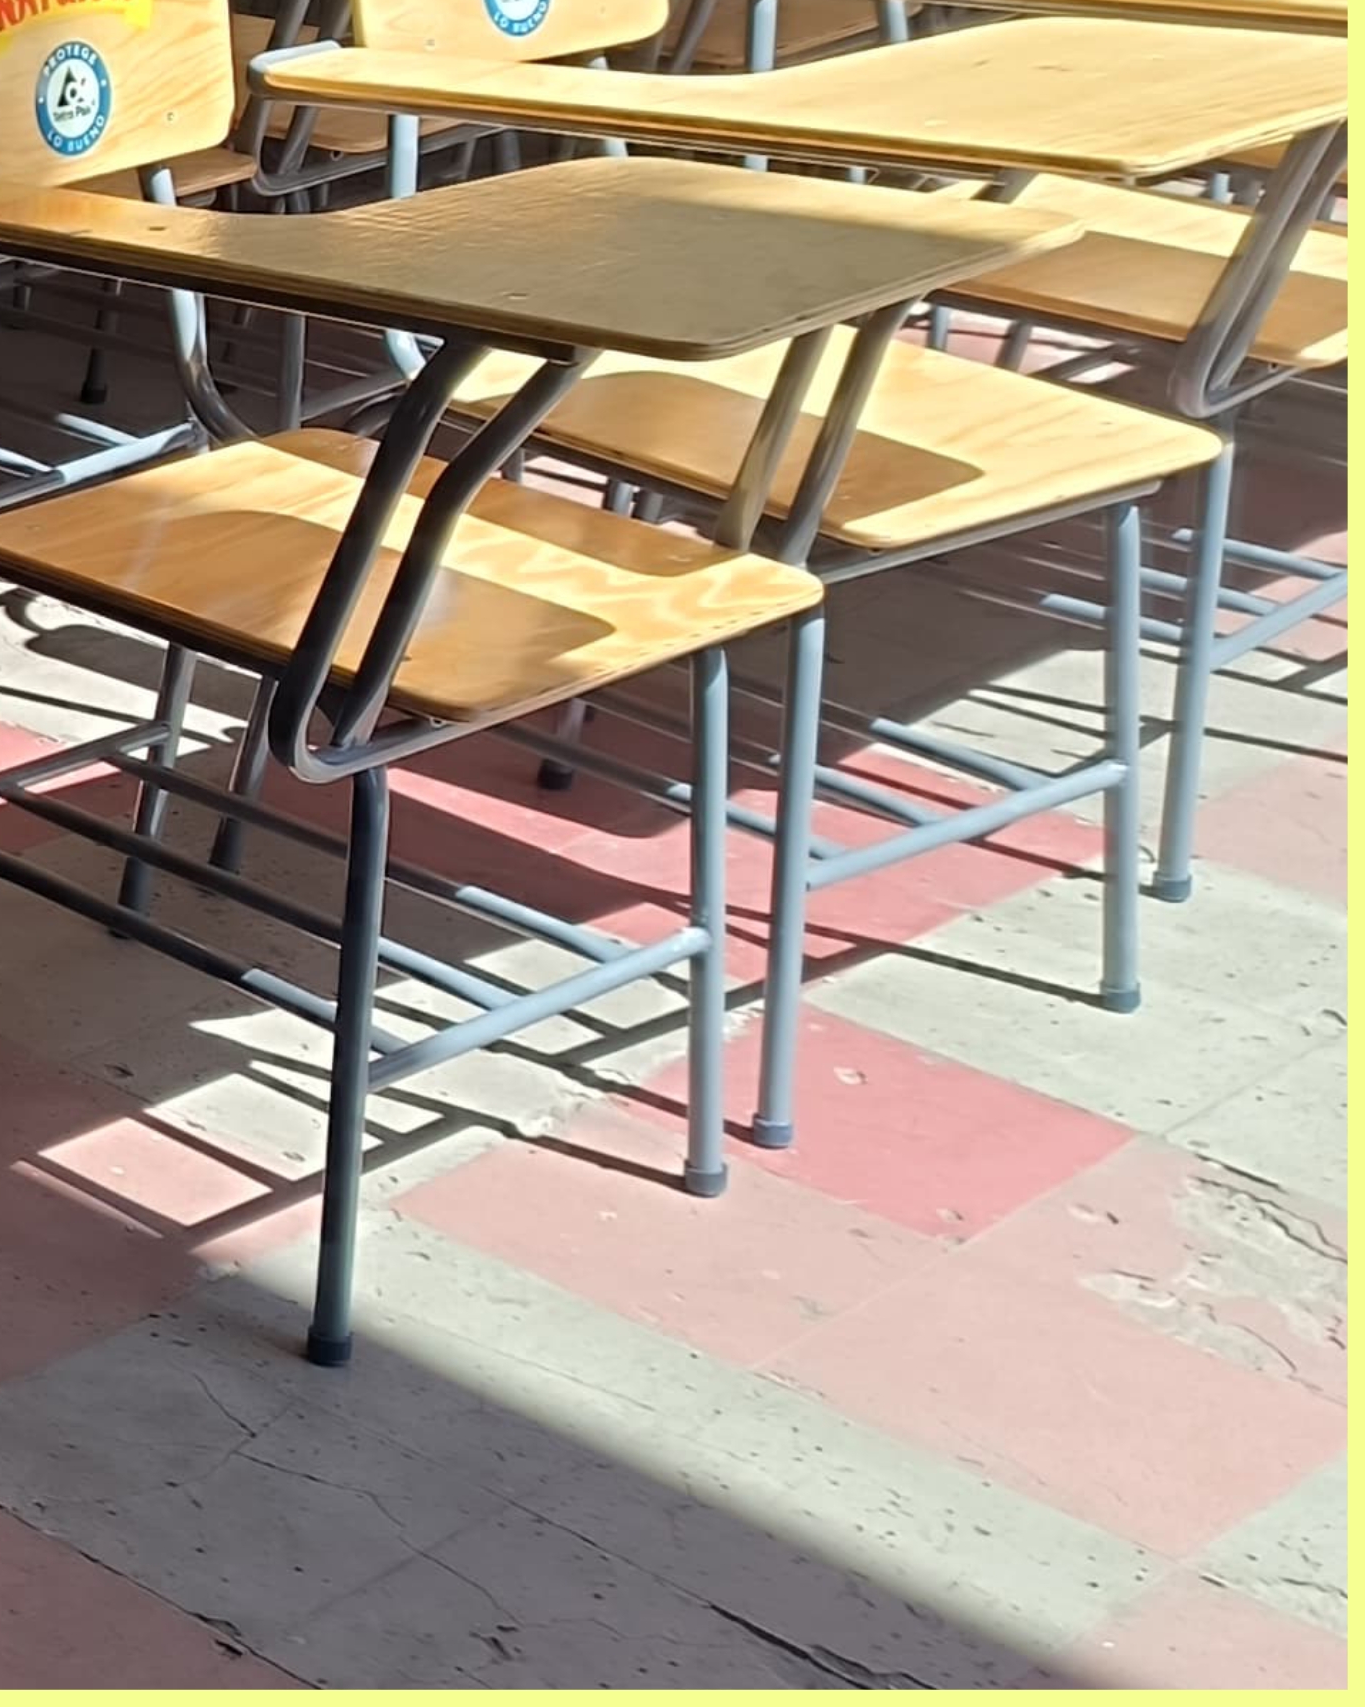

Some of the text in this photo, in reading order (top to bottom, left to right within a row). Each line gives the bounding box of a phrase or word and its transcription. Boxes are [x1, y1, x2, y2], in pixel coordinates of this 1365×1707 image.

[42, 42, 95, 74] PROTEGE
[46, 111, 103, 155] LO BUENO
